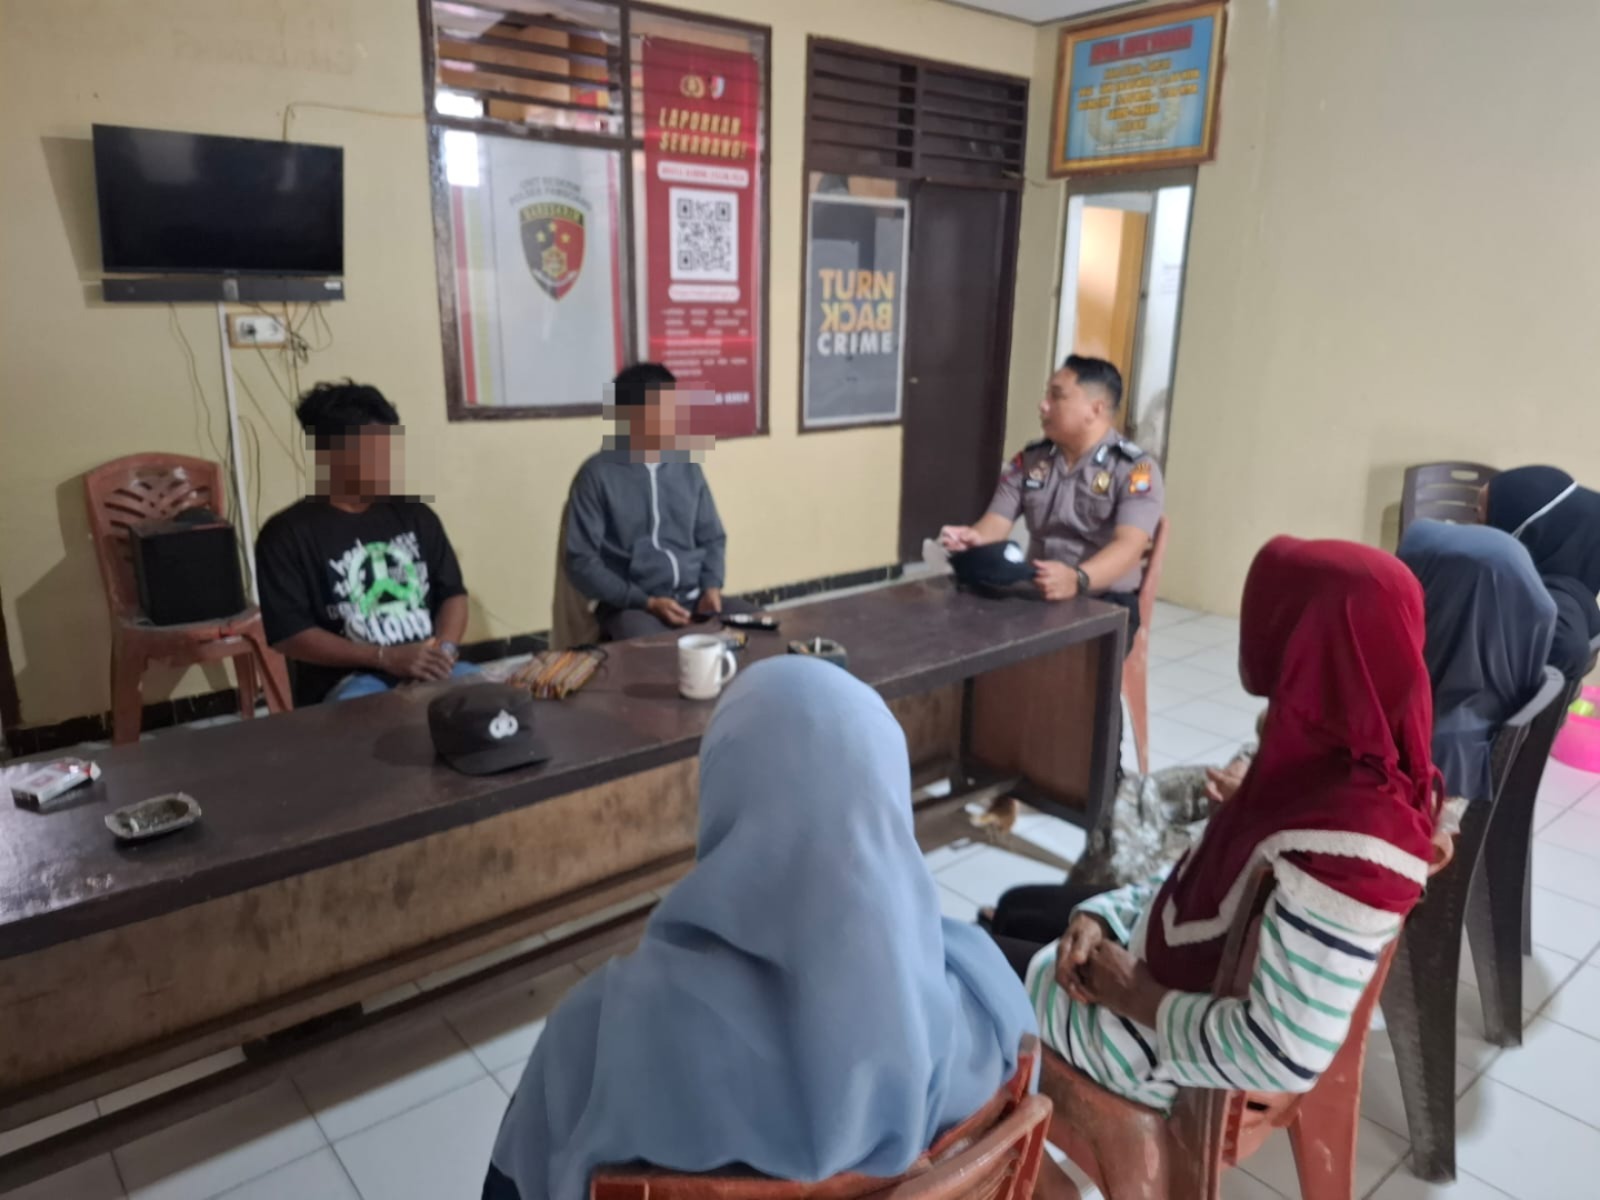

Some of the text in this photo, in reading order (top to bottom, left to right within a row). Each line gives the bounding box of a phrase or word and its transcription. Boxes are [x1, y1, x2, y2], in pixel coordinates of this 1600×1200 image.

[659, 107, 741, 136] LAPORKAN
[818, 268, 896, 301] TURN
[817, 332, 894, 356] CRIME
